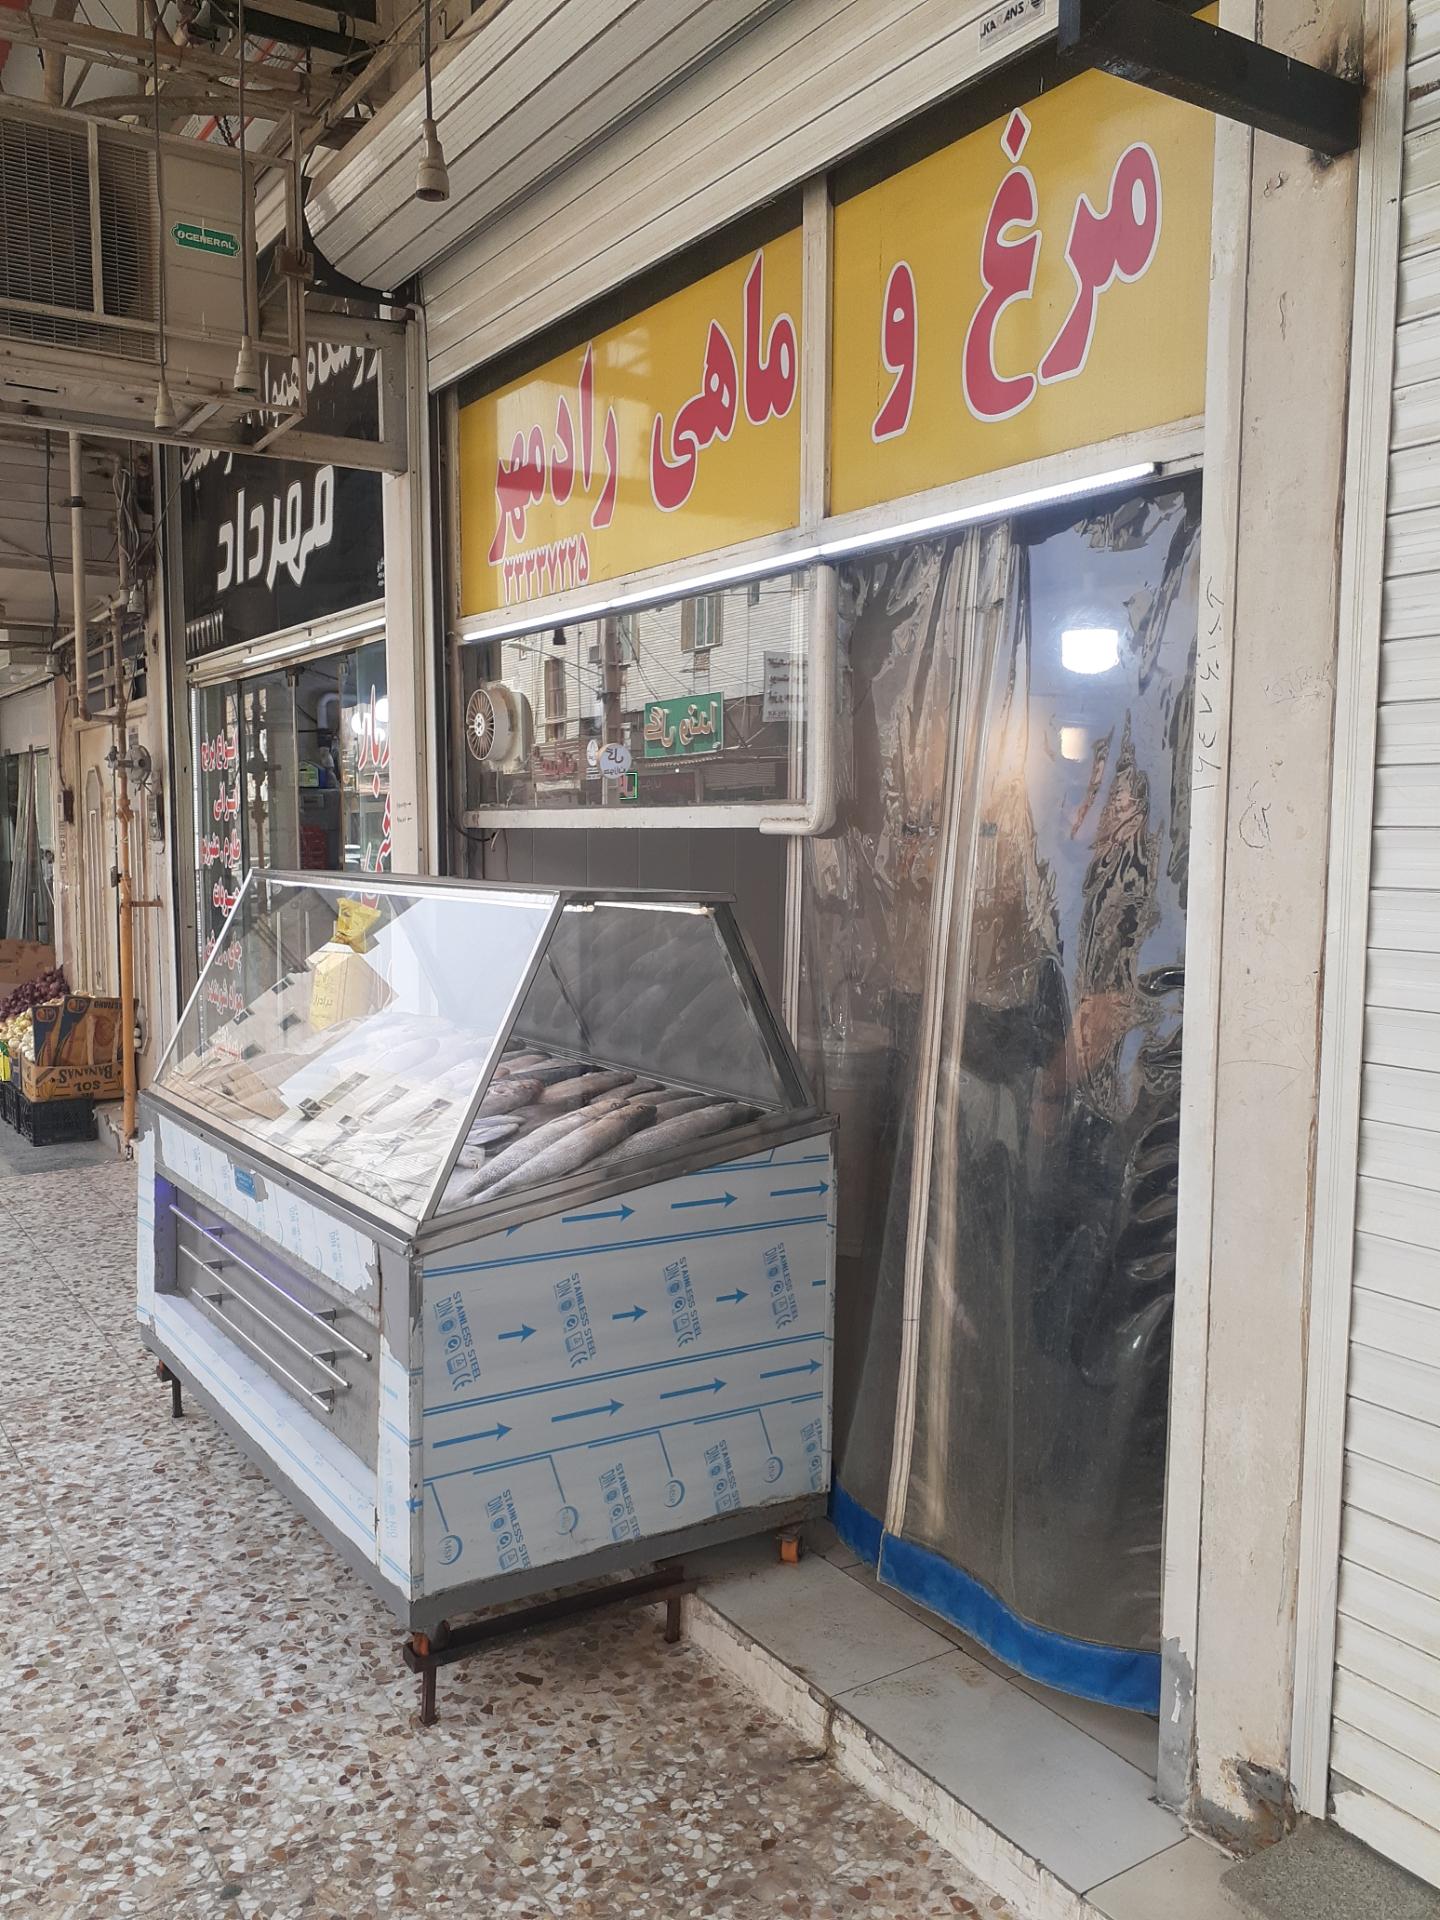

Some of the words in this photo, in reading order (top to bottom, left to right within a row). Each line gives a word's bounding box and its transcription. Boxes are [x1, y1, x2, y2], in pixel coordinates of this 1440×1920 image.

[963, 107, 1163, 423] مرغ
[649, 248, 799, 514] ماهی
[871, 260, 919, 444] و
[487, 341, 619, 567] رادمهر
[217, 464, 335, 594] مهرداد
[58, 1065, 113, 1084] BANANAS
[571, 1272, 590, 1327] STAINLESS
[583, 1327, 597, 1360] STEEL
[679, 1256, 696, 1308] STAINLESS
[690, 1309, 702, 1340] STEEL
[777, 1242, 793, 1292] STAINLESS
[788, 1293, 799, 1321] STEEL
[452, 1291, 473, 1347] STAINLESS
[467, 1349, 481, 1382] STEEL
[615, 1462, 635, 1515] STAINLESS
[719, 1440, 737, 1490] STAINLESS
[502, 1488, 524, 1543] STAINLESS
